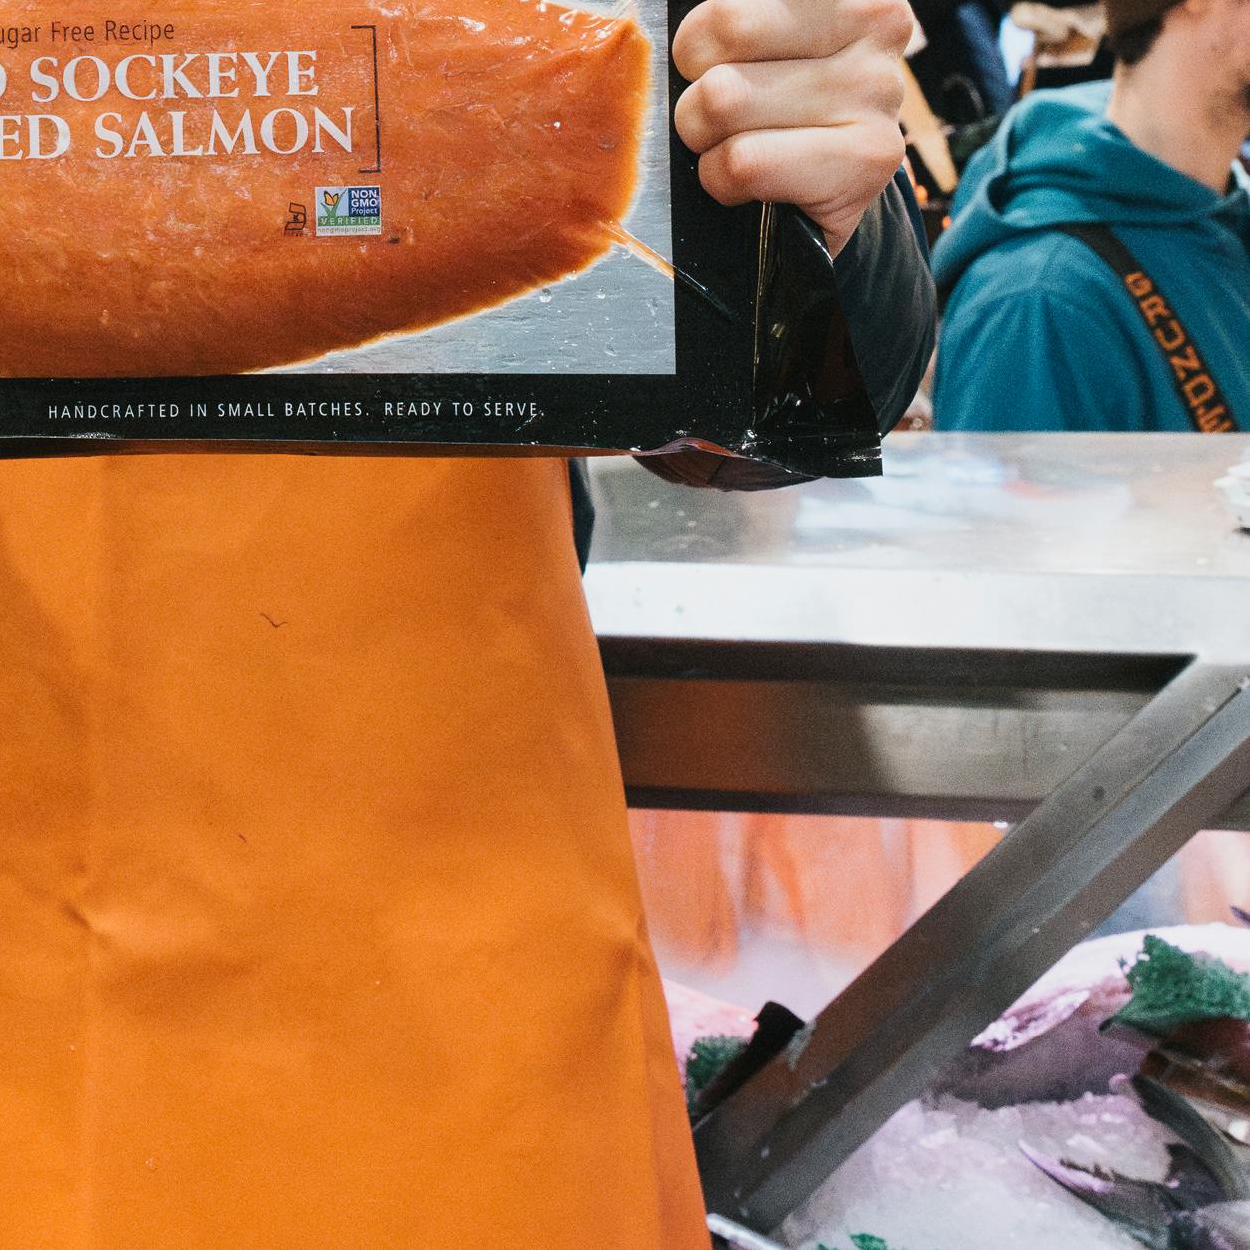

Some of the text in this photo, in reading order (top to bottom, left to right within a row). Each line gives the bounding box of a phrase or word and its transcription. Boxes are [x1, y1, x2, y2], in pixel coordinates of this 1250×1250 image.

[51, 21, 95, 43] Free
[105, 19, 175, 47] Recipe
[30, 50, 320, 102] SOCKEYE
[94, 106, 355, 160] SALMON
[351, 189, 378, 199] NON
[351, 198, 378, 208] GMO
[351, 207, 378, 216] Project
[321, 216, 378, 225] VERIFIED
[48, 402, 544, 419] HANDCRAFTED IN SMALL BATCHES. READY TO SERVE.
